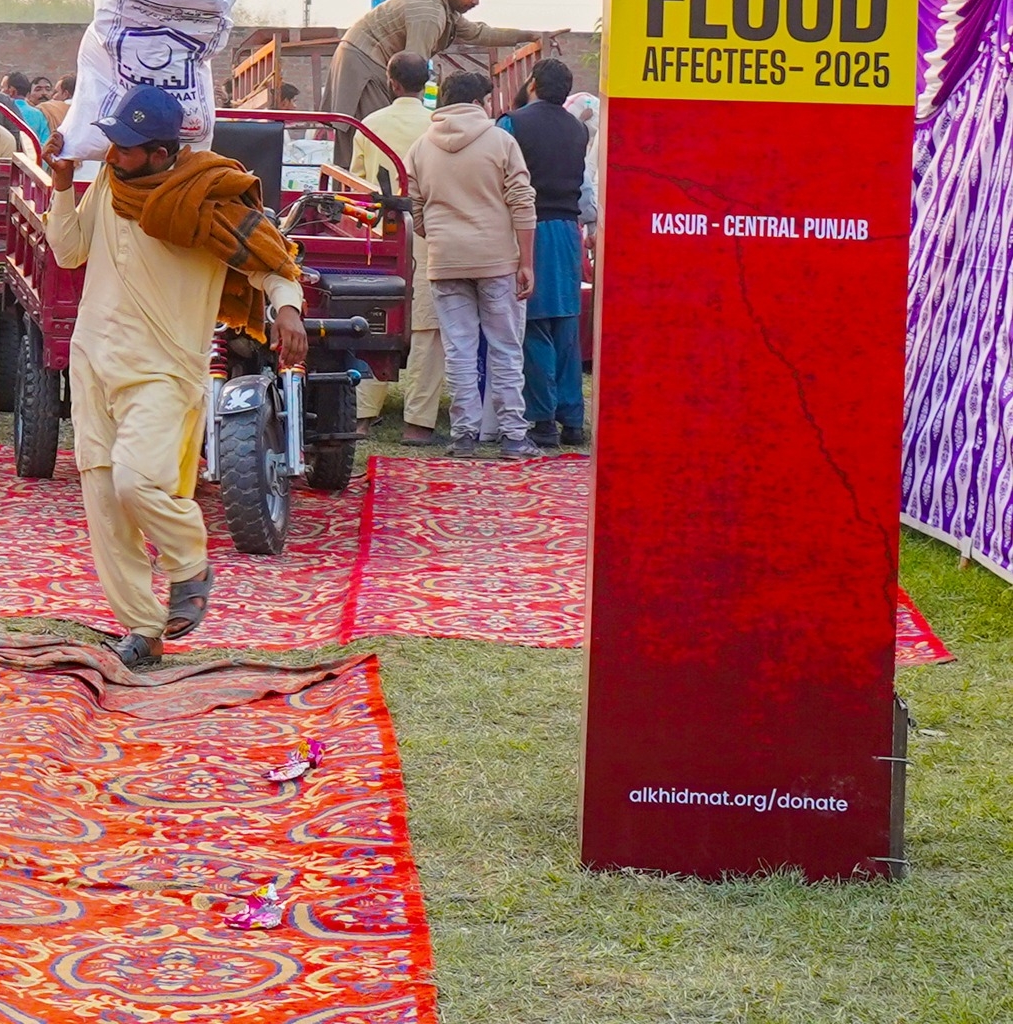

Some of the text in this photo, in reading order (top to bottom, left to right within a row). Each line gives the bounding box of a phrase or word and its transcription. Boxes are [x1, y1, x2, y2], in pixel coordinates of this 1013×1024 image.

[815, 51, 889, 88] 2025
[652, 213, 707, 235] KASUR
[724, 215, 799, 238] CENTRAL
[804, 218, 868, 240] PUNJAB
[630, 787, 848, 812] alkhidmat.org/donate
